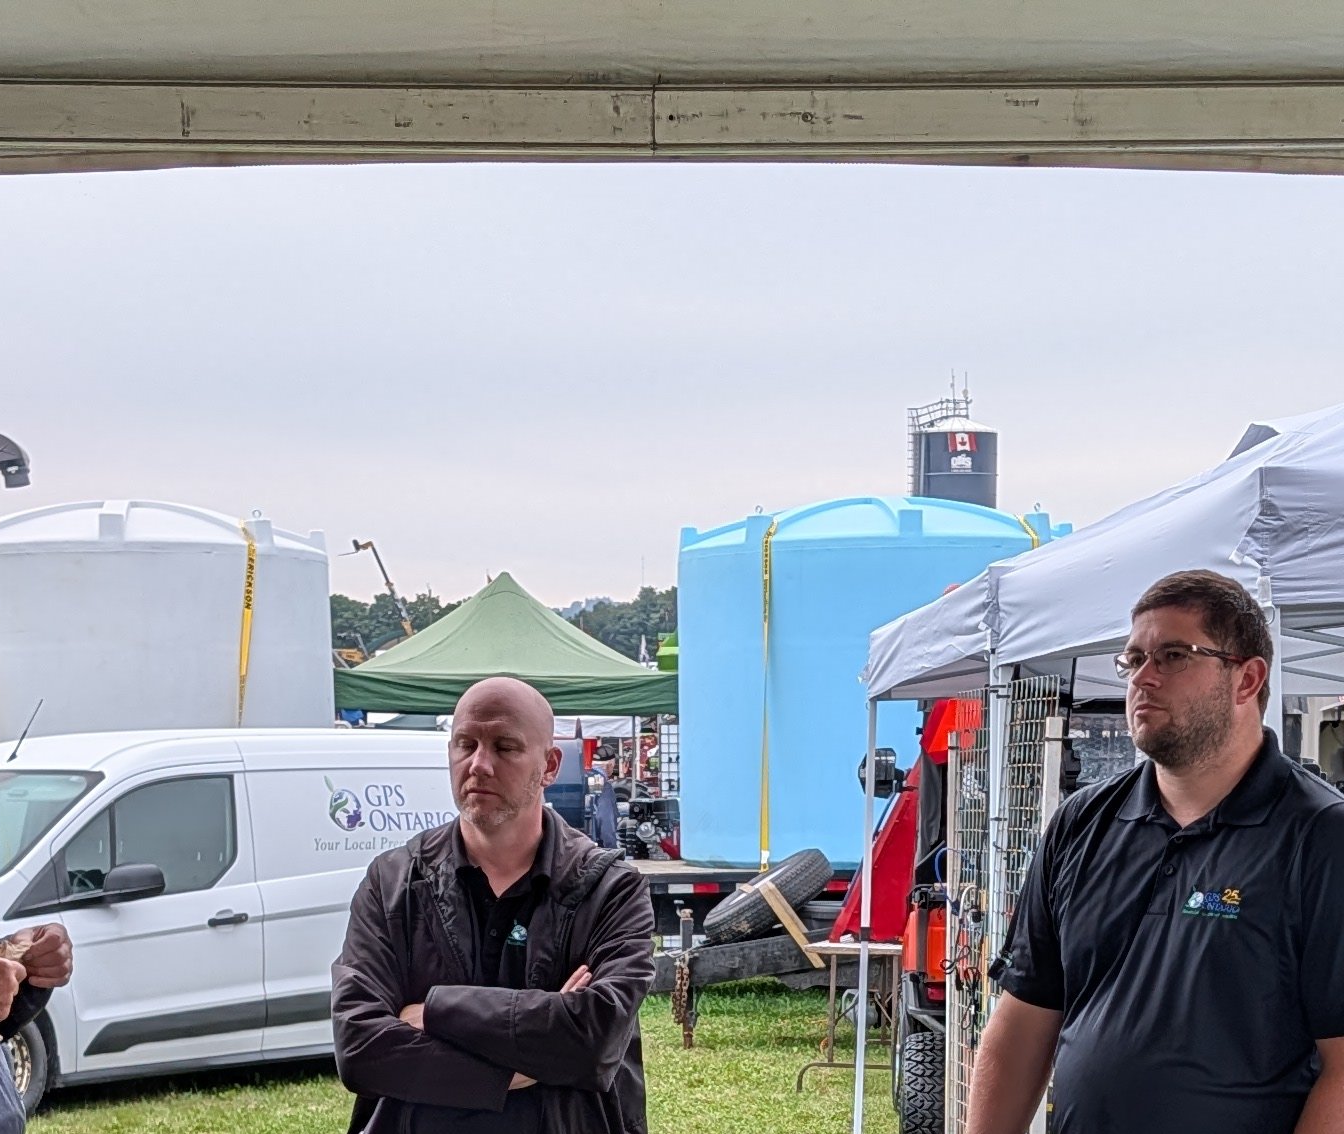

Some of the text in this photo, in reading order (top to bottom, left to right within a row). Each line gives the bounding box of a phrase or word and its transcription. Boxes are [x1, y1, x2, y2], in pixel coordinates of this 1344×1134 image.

[244, 557, 256, 611] ERICKSON
[364, 784, 405, 807] GPS
[314, 837, 341, 852] Your
[344, 837, 376, 852] Local
